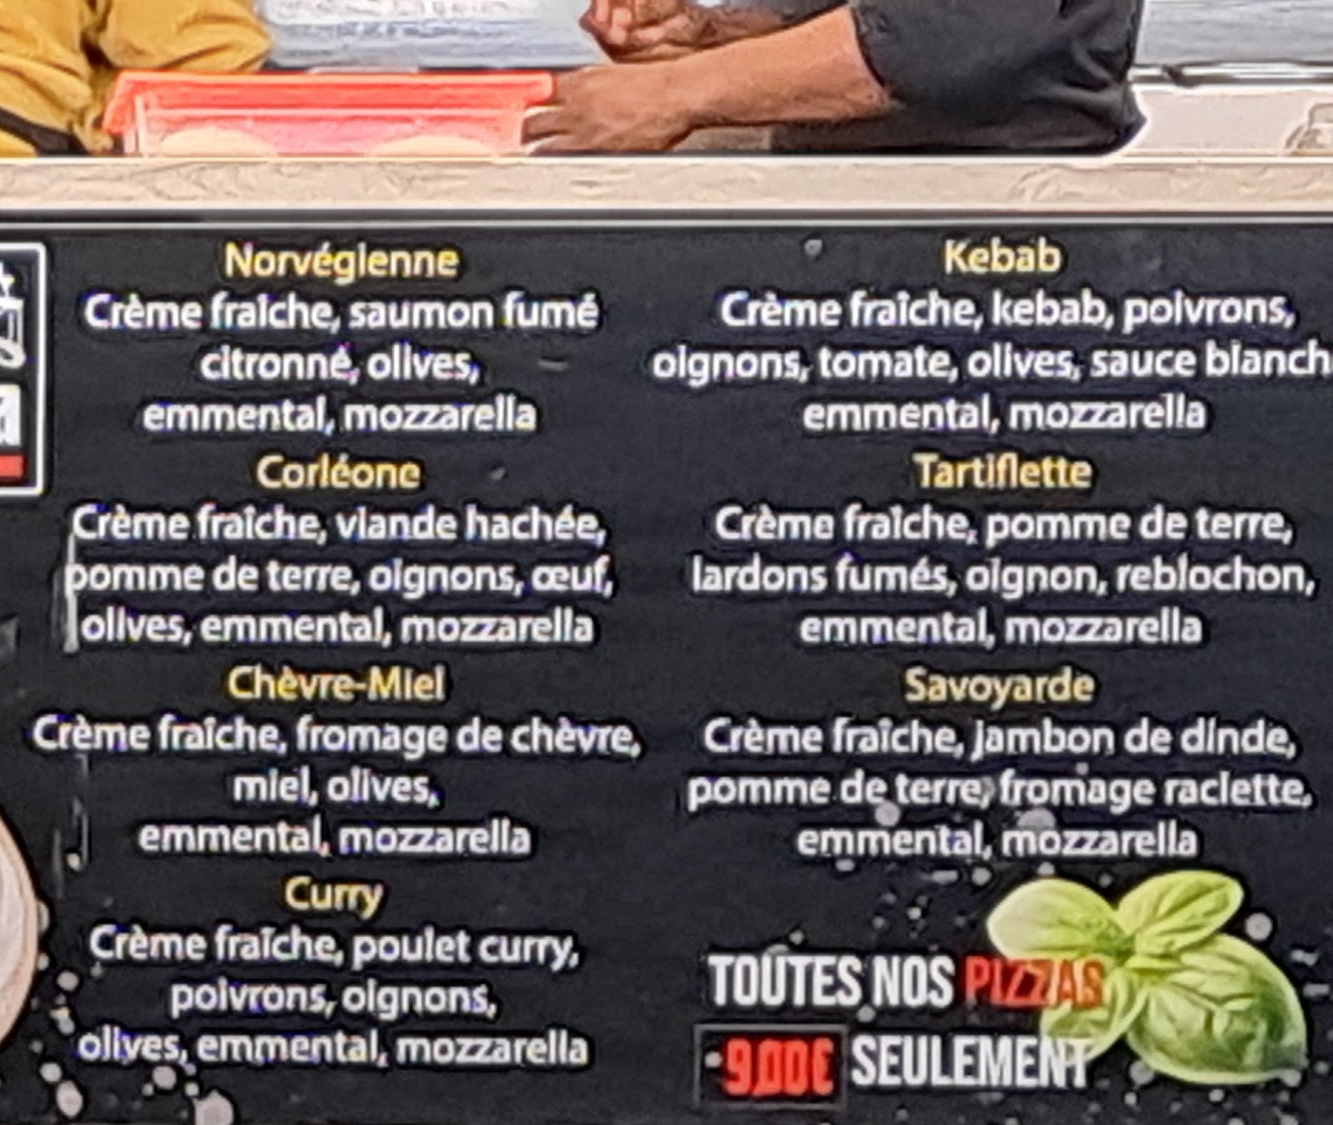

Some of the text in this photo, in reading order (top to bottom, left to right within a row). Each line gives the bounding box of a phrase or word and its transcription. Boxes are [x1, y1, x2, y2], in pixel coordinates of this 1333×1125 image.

[225, 243, 459, 285] Norvégienne
[944, 240, 1062, 274] Kebab
[84, 293, 203, 331] Crème
[348, 300, 494, 331] saumon
[502, 293, 599, 330] fumé
[720, 291, 843, 328] Crème
[991, 291, 1115, 331] kebab,
[1122, 291, 1295, 334] poivrons,
[200, 344, 480, 385] citronné, olives,
[652, 341, 1333, 385] oignons, tomate, olives, sauce blanch
[257, 455, 421, 490] Corléone
[914, 453, 1092, 489] Tartiflette
[65, 556, 205, 598] pomme
[212, 556, 259, 592] de
[266, 559, 361, 597] terre,
[368, 557, 525, 598] oignons,
[692, 555, 1315, 598] lardons fumés, oignon, reblochon,
[227, 665, 445, 702] Chèvre-Miel
[905, 666, 1096, 711] Savoyarde
[32, 715, 151, 753] Crème
[296, 715, 448, 759] fromage
[456, 715, 503, 754] de
[510, 715, 641, 758] chèvre,
[704, 717, 823, 755] Crème
[970, 717, 1114, 761] jambon
[1124, 717, 1172, 755] de
[1180, 717, 1296, 759] dinde,
[233, 767, 439, 807] miel, olives,
[688, 775, 831, 812] pomme
[840, 770, 887, 805] de
[999, 770, 1156, 812] fromage
[1164, 770, 1312, 809] raclette,
[797, 822, 1197, 861] emmental, mozzarella
[285, 877, 384, 918] Curry
[89, 925, 207, 962] Crème
[353, 926, 471, 971] poulet
[479, 934, 579, 971] curry,
[171, 979, 496, 1021] poivrons, oignons,
[708, 954, 1104, 1007] TOUTES NOS PIZZAS
[197, 1028, 387, 1068] emmental,
[396, 1028, 588, 1065] mozzarella
[852, 1035, 1094, 1088] SEULEMENT
